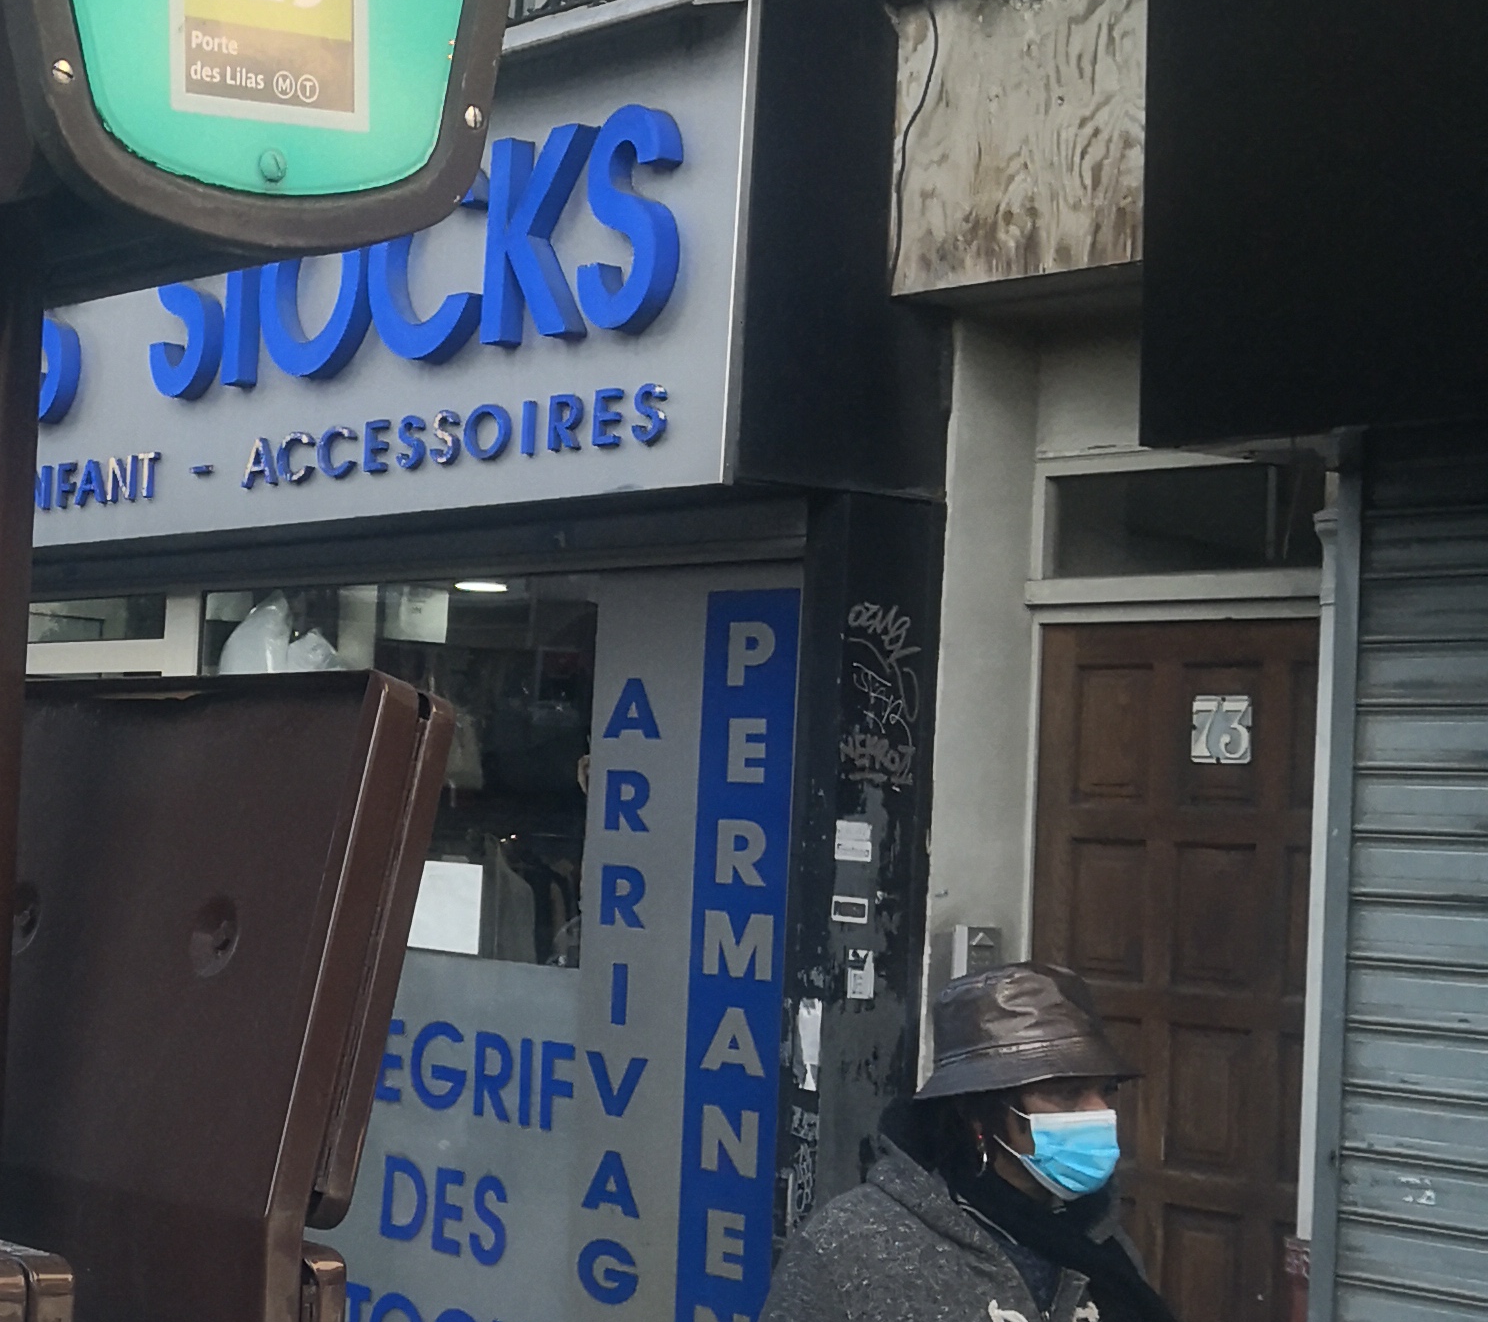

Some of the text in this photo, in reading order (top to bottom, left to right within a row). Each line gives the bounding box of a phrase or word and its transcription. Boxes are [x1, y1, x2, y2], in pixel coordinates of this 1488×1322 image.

[190, 61, 220, 83] des
[225, 66, 265, 90] Lilas
[191, 30, 238, 55] Porte
[34, 451, 161, 511] NFANT
[241, 383, 668, 490] ACCESSOIRES
[374, 1018, 576, 1132] EGRIF
[380, 1154, 508, 1267] DES
